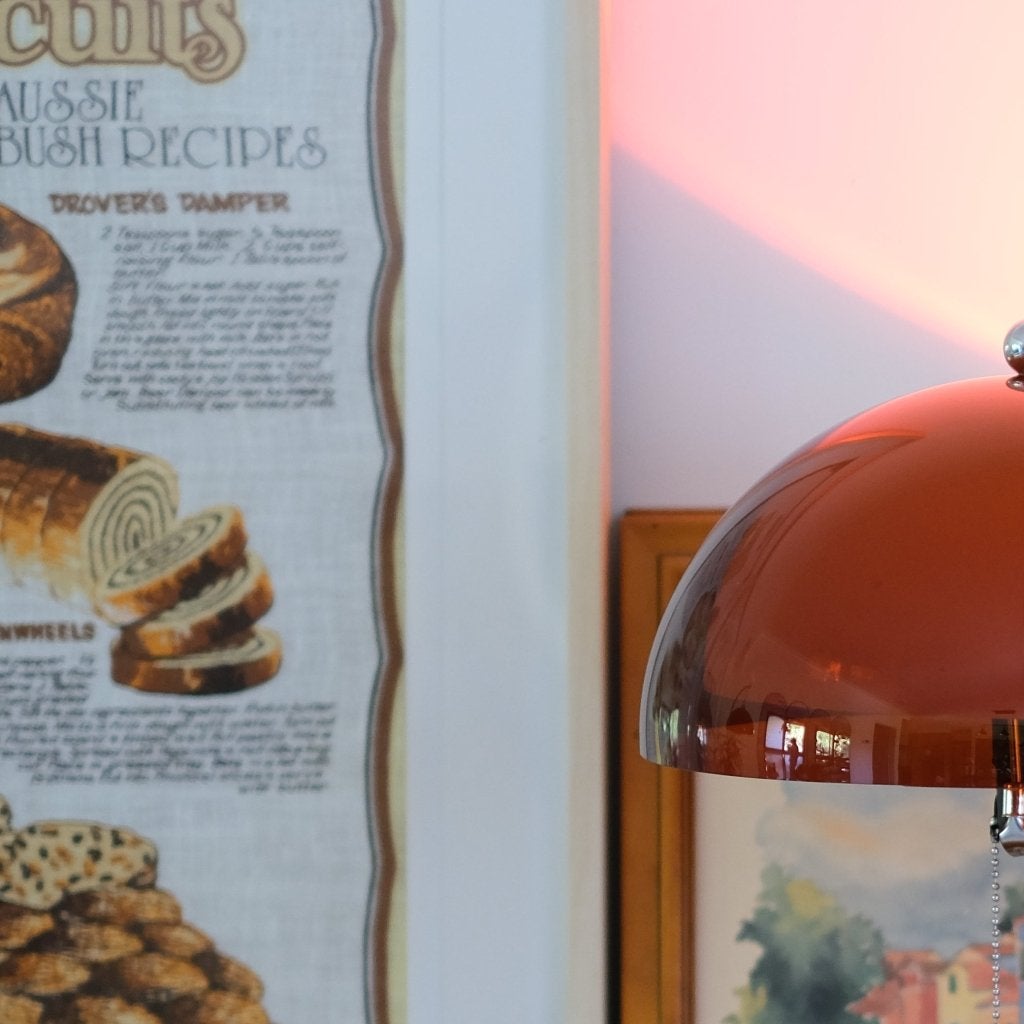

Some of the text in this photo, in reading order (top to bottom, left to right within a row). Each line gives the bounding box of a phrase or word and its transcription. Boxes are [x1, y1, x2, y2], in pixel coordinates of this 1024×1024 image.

[0, 79, 144, 123] AUSSIE
[0, 126, 328, 169] BUSH RECIPES
[48, 189, 290, 214] DROVER'S DAMPER
